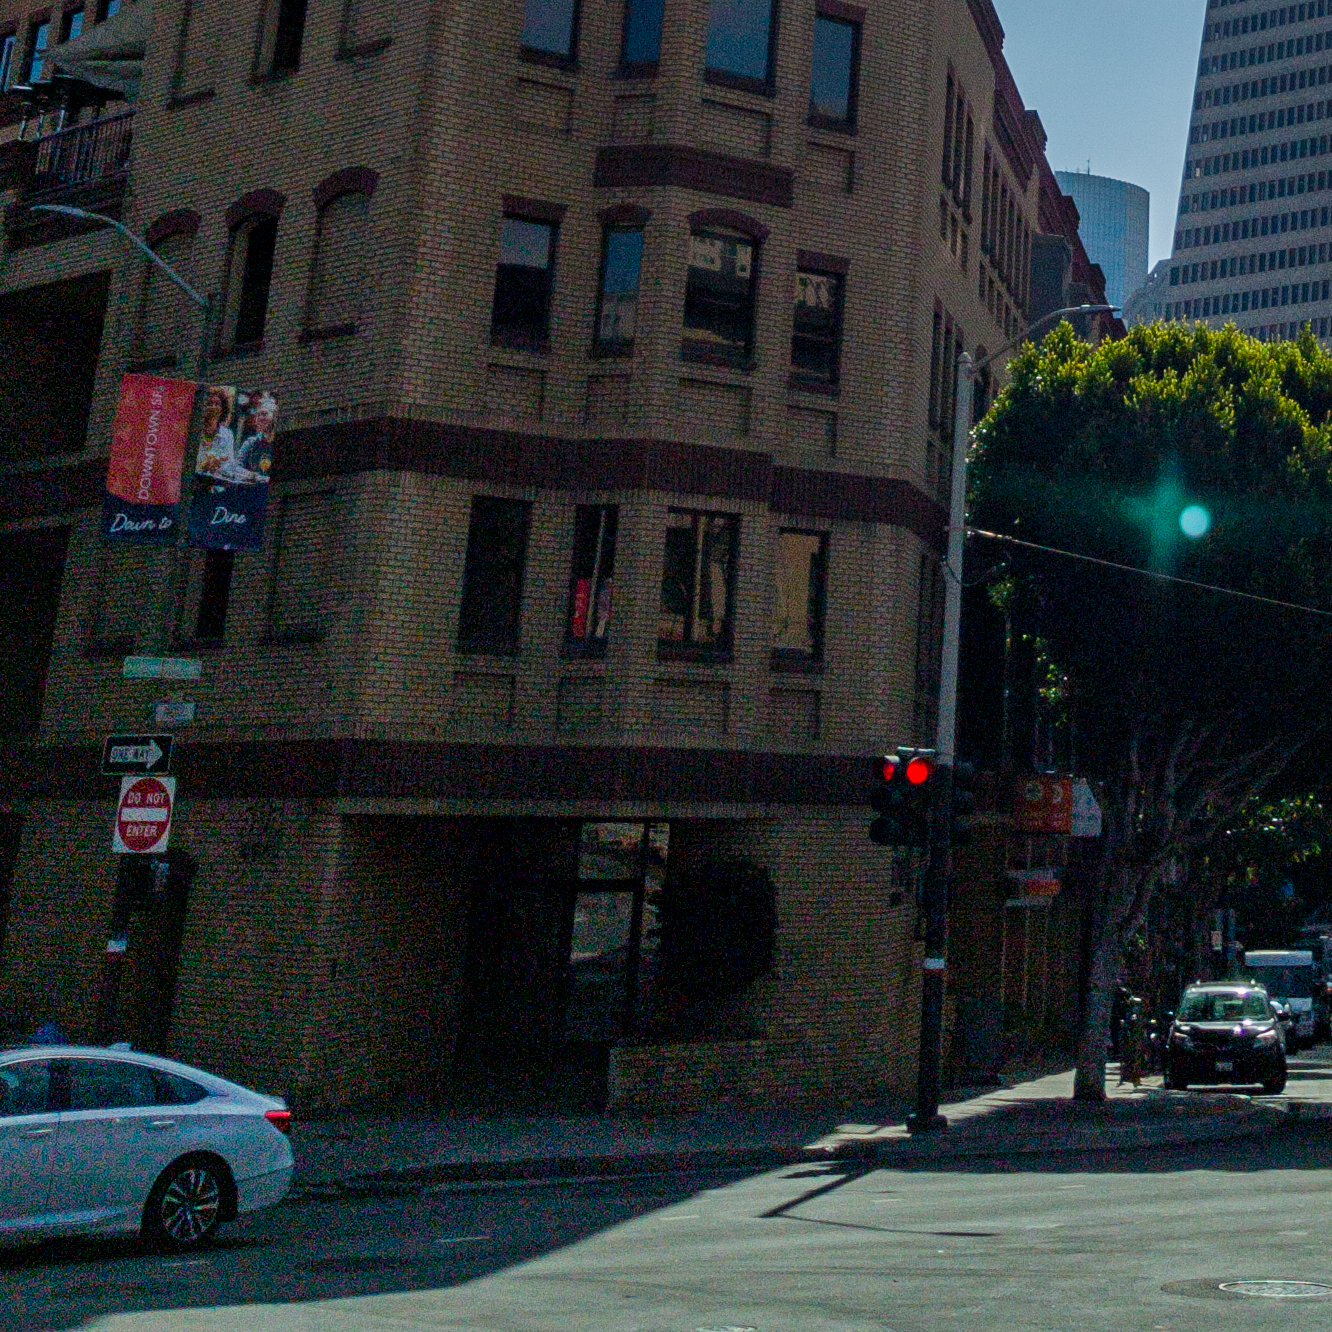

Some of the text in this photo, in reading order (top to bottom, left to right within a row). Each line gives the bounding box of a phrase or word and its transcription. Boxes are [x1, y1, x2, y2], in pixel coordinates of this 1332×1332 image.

[138, 410, 161, 500] DOWNTOWN
[211, 506, 246, 525] Dine
[158, 516, 173, 530] to
[127, 792, 166, 805] DO NOT
[126, 824, 158, 838] ENTER
